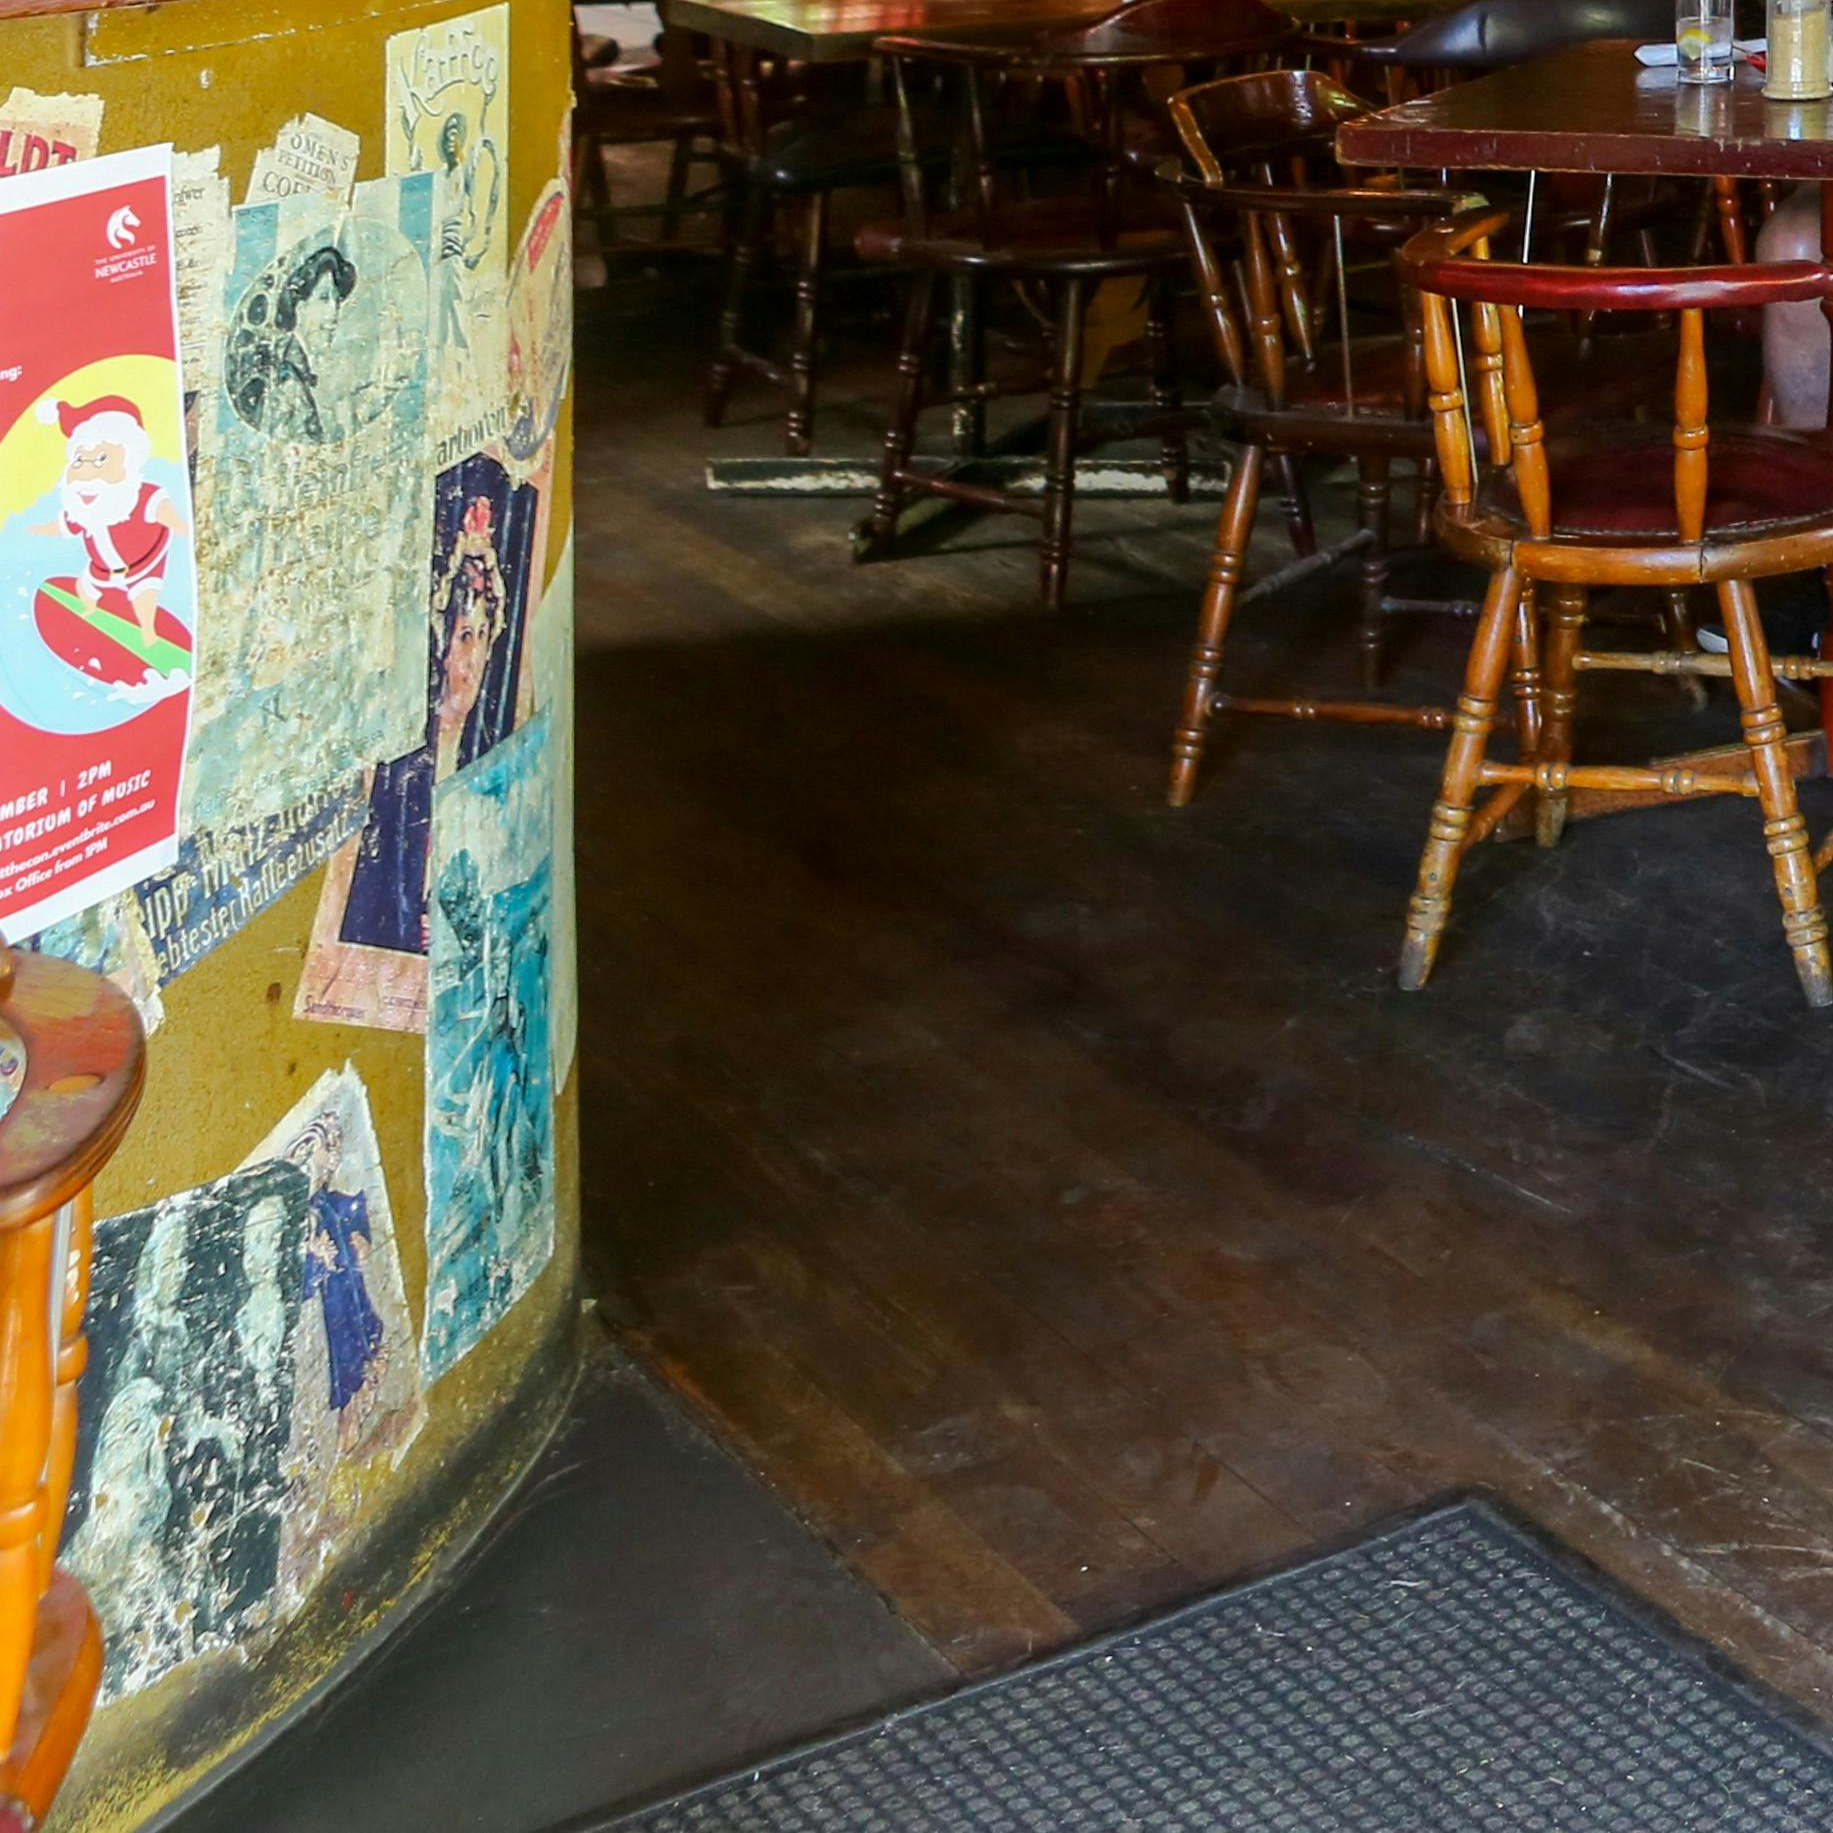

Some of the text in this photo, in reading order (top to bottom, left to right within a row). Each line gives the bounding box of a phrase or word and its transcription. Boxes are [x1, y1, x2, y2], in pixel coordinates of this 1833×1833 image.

[95, 253, 157, 279] NEWCASTLE
[77, 760, 112, 790] 2PM
[77, 794, 98, 818] OF
[101, 769, 151, 807] MUSIC
[15, 868, 53, 892] Office
[54, 855, 83, 875] from
[85, 837, 109, 860] 1PM
